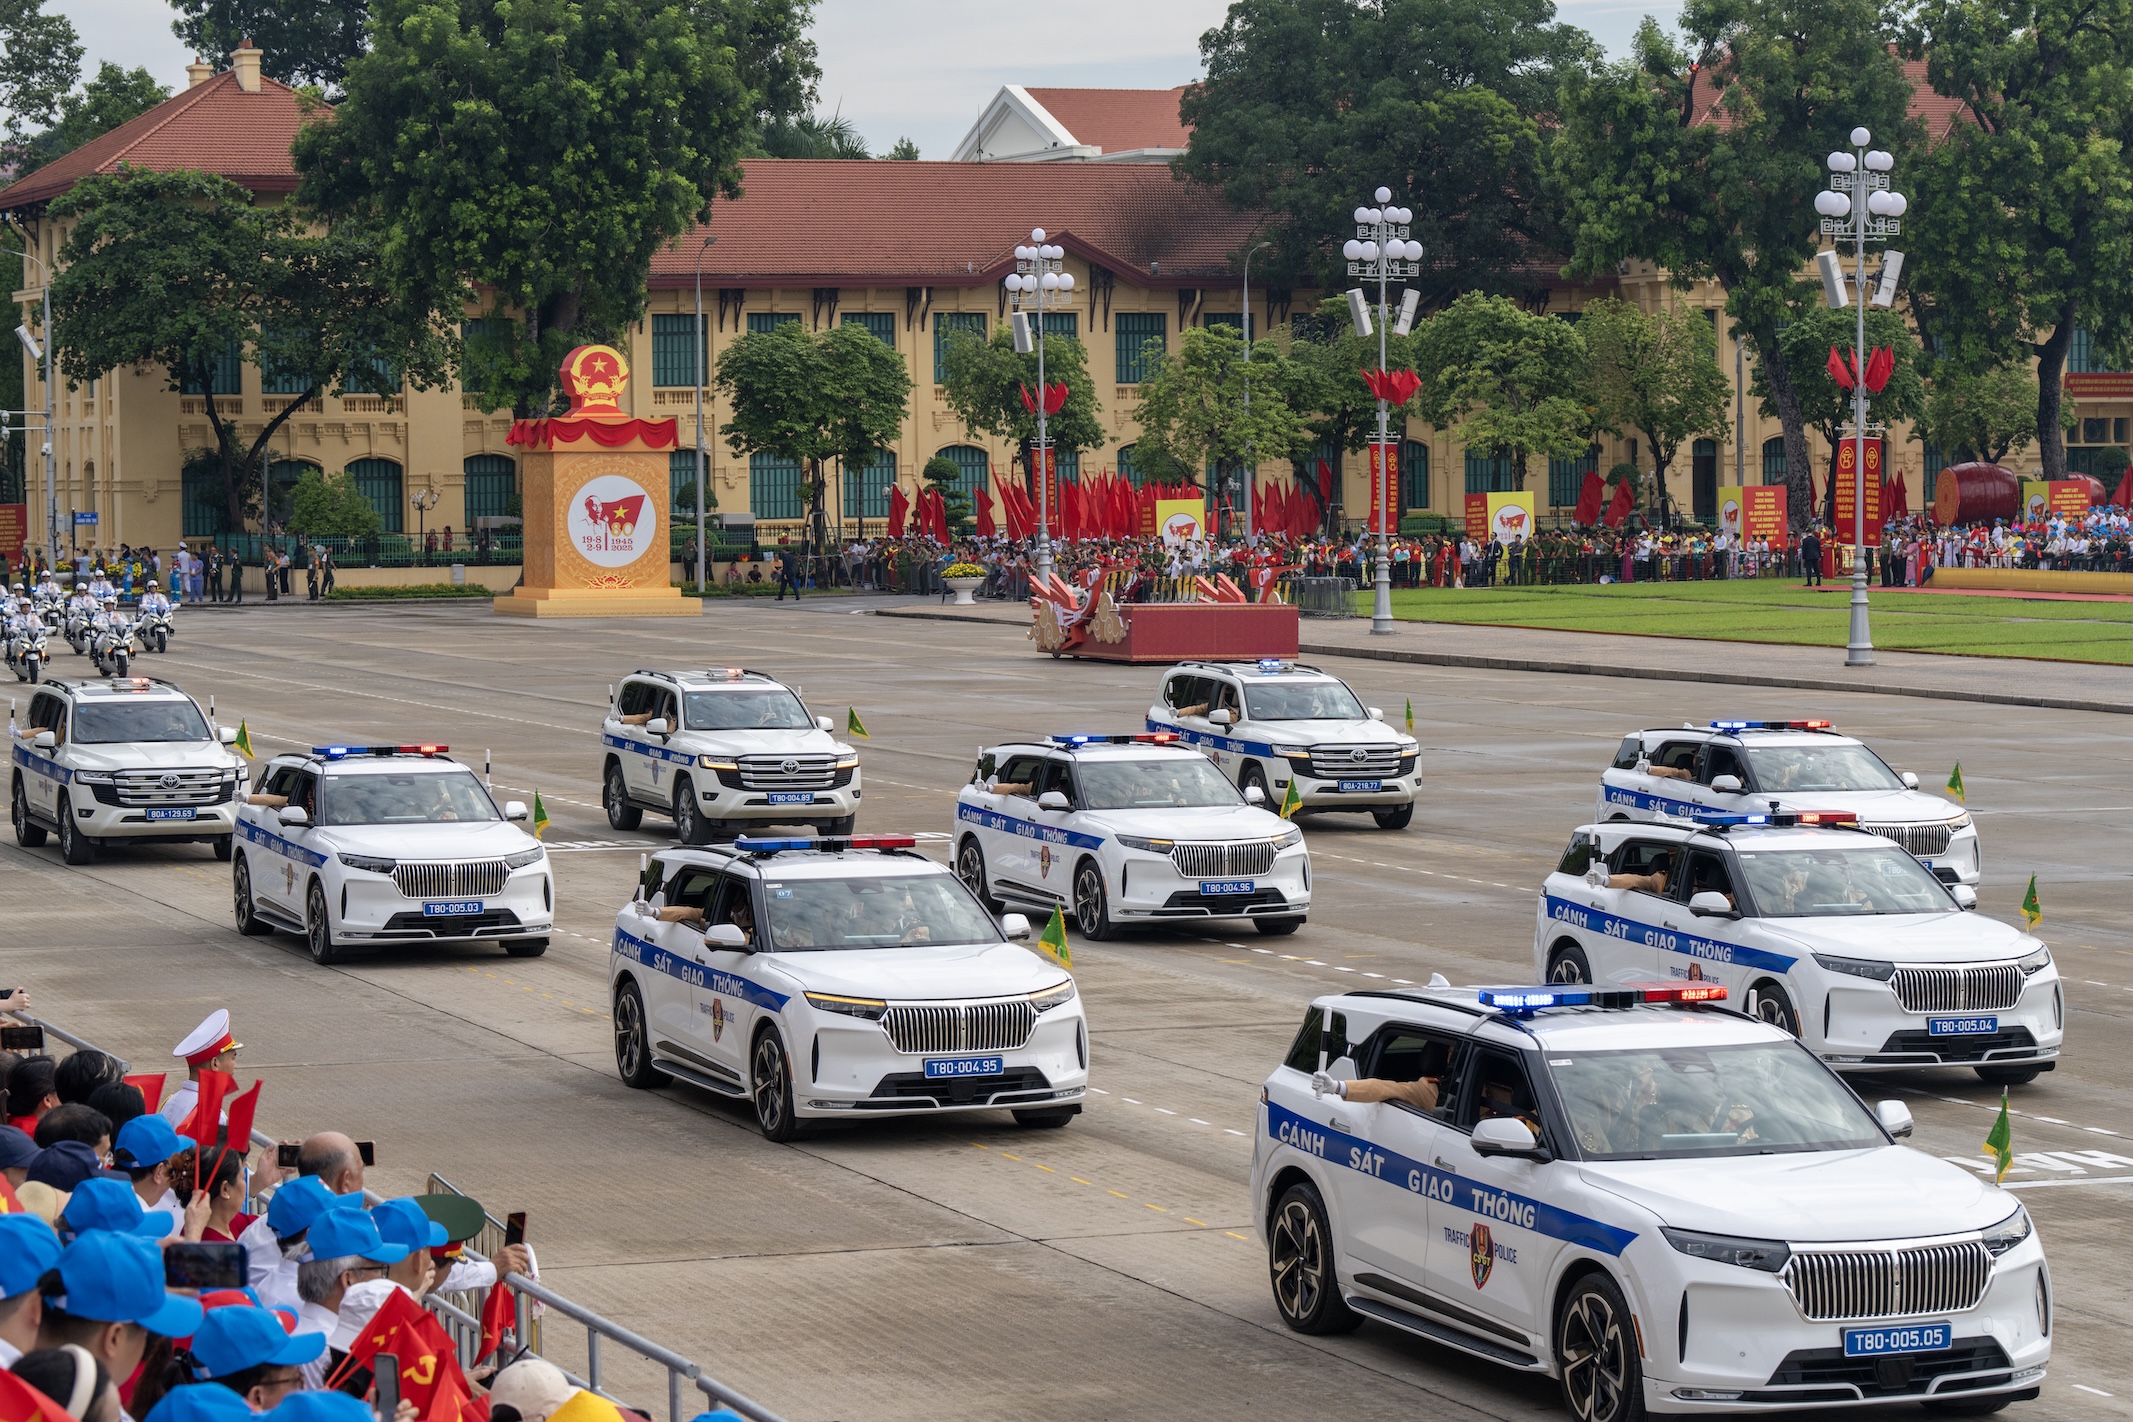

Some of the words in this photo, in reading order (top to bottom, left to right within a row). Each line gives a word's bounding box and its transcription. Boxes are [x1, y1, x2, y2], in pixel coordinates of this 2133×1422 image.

[611, 522, 634, 537] 80
[1200, 735, 1214, 746] GIAO
[1226, 740, 1244, 752] THÔNG
[649, 748, 662, 758] GIAO
[1649, 798, 1667, 813] SÁT
[991, 816, 1006, 831] SÁT
[1016, 824, 1035, 838] GIAO
[1042, 828, 1068, 844] THÔNG
[255, 830, 266, 845] SÁT
[270, 839, 283, 853] GIAO
[1206, 883, 1250, 892] T80-004.96
[429, 903, 478, 913] T80-005.03
[1604, 919, 1629, 939] SÁT
[1645, 930, 1676, 950] GIAO
[1689, 939, 1732, 962] THÔNG
[654, 953, 672, 974] SÁT
[682, 966, 704, 987] GIAO
[713, 974, 744, 997] THÔNG
[1670, 966, 1688, 979] TRAFFIC
[1936, 1020, 1992, 1032] T80-005.04
[932, 1060, 997, 1074] T80-004.95
[1349, 1146, 1385, 1176] SÁT
[1408, 1170, 1454, 1202] GIAO
[1472, 1188, 1536, 1229] THÔNG
[1444, 1227, 1470, 1248] TRAFFIC
[1494, 1243, 1517, 1264] POLICE
[1855, 1329, 1943, 1350] T80-005.05
